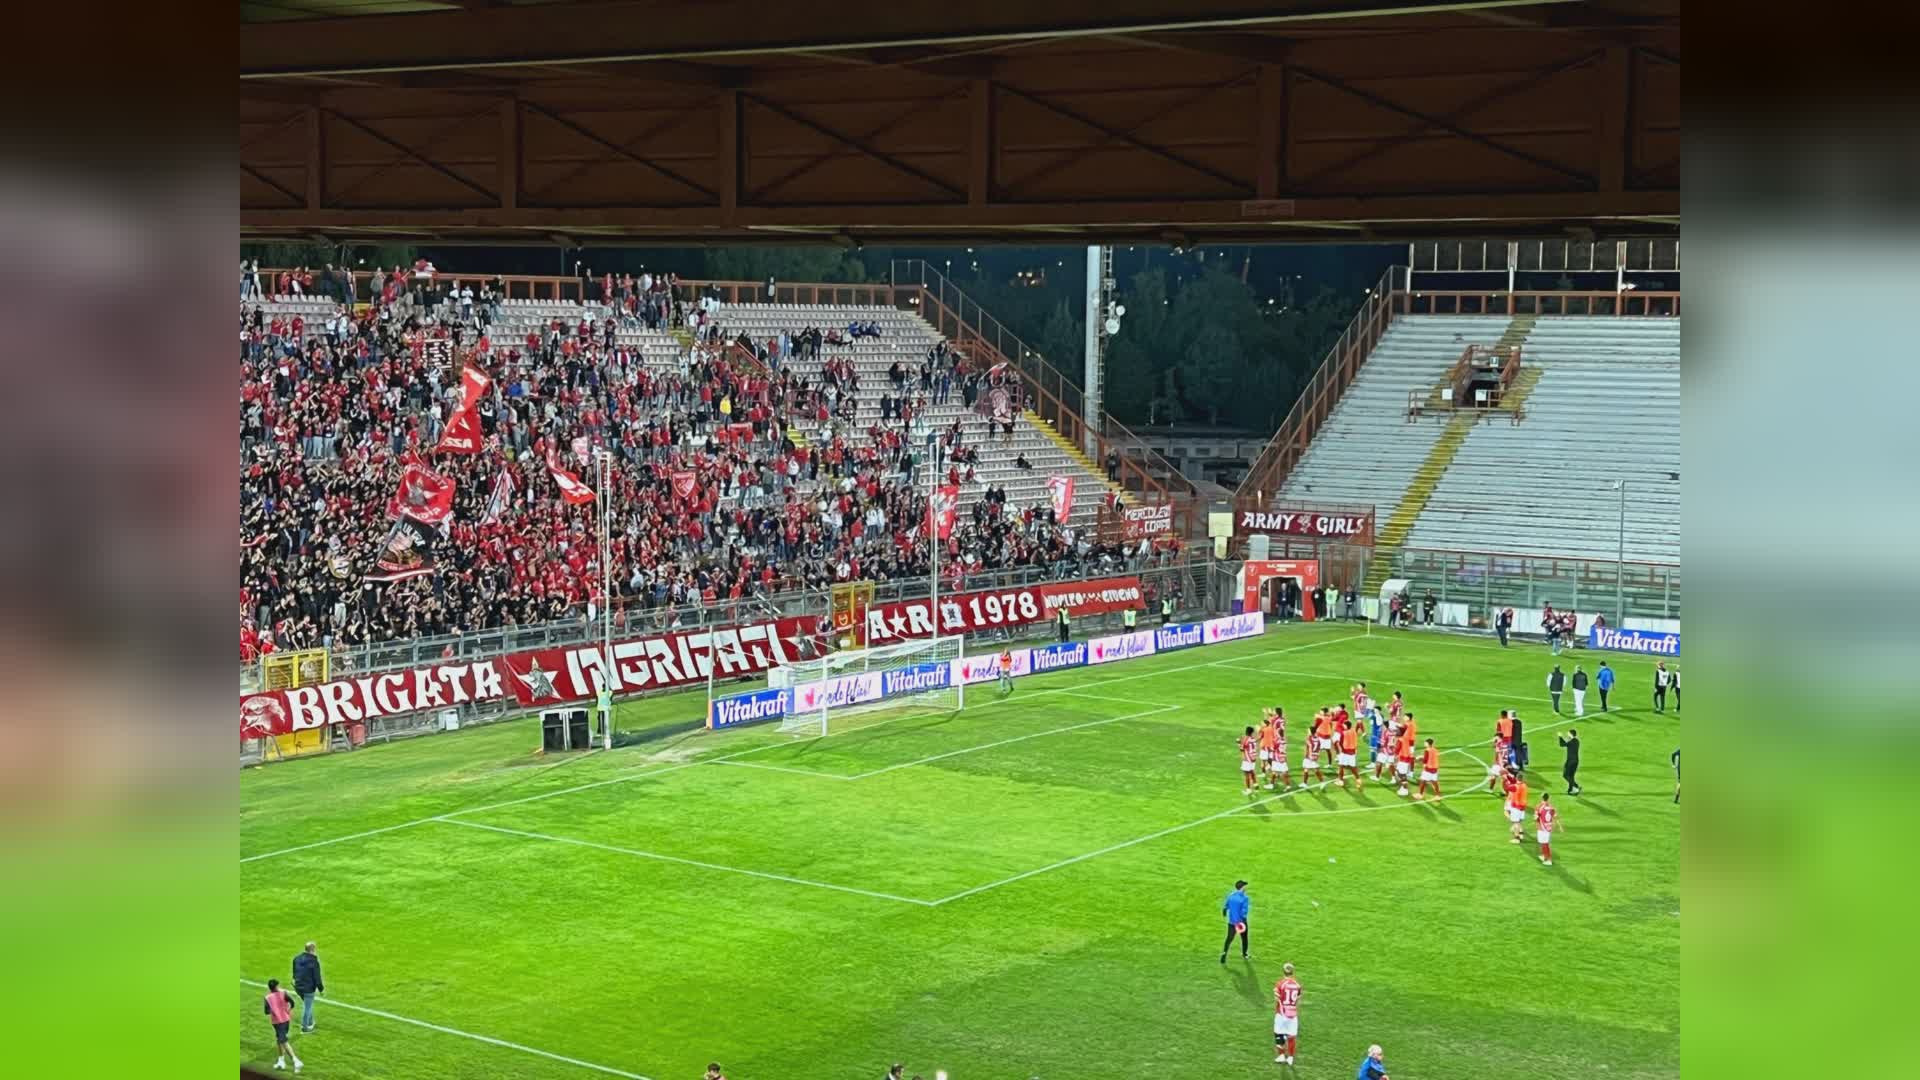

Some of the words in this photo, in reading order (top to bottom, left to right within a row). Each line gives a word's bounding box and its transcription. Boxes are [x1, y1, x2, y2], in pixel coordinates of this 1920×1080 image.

[1241, 512, 1295, 530] ARMY
[1316, 516, 1364, 535] GIRLS
[969, 591, 1038, 625] 1978
[1157, 626, 1201, 649] Vitakraft
[1595, 627, 1678, 654] Vitakraft
[1033, 643, 1085, 670] Vitakraft
[885, 664, 946, 693] Vitakraft
[284, 660, 503, 732] BRIGATA
[716, 690, 789, 724] Vitakraft
[1544, 810, 1552, 822] 6
